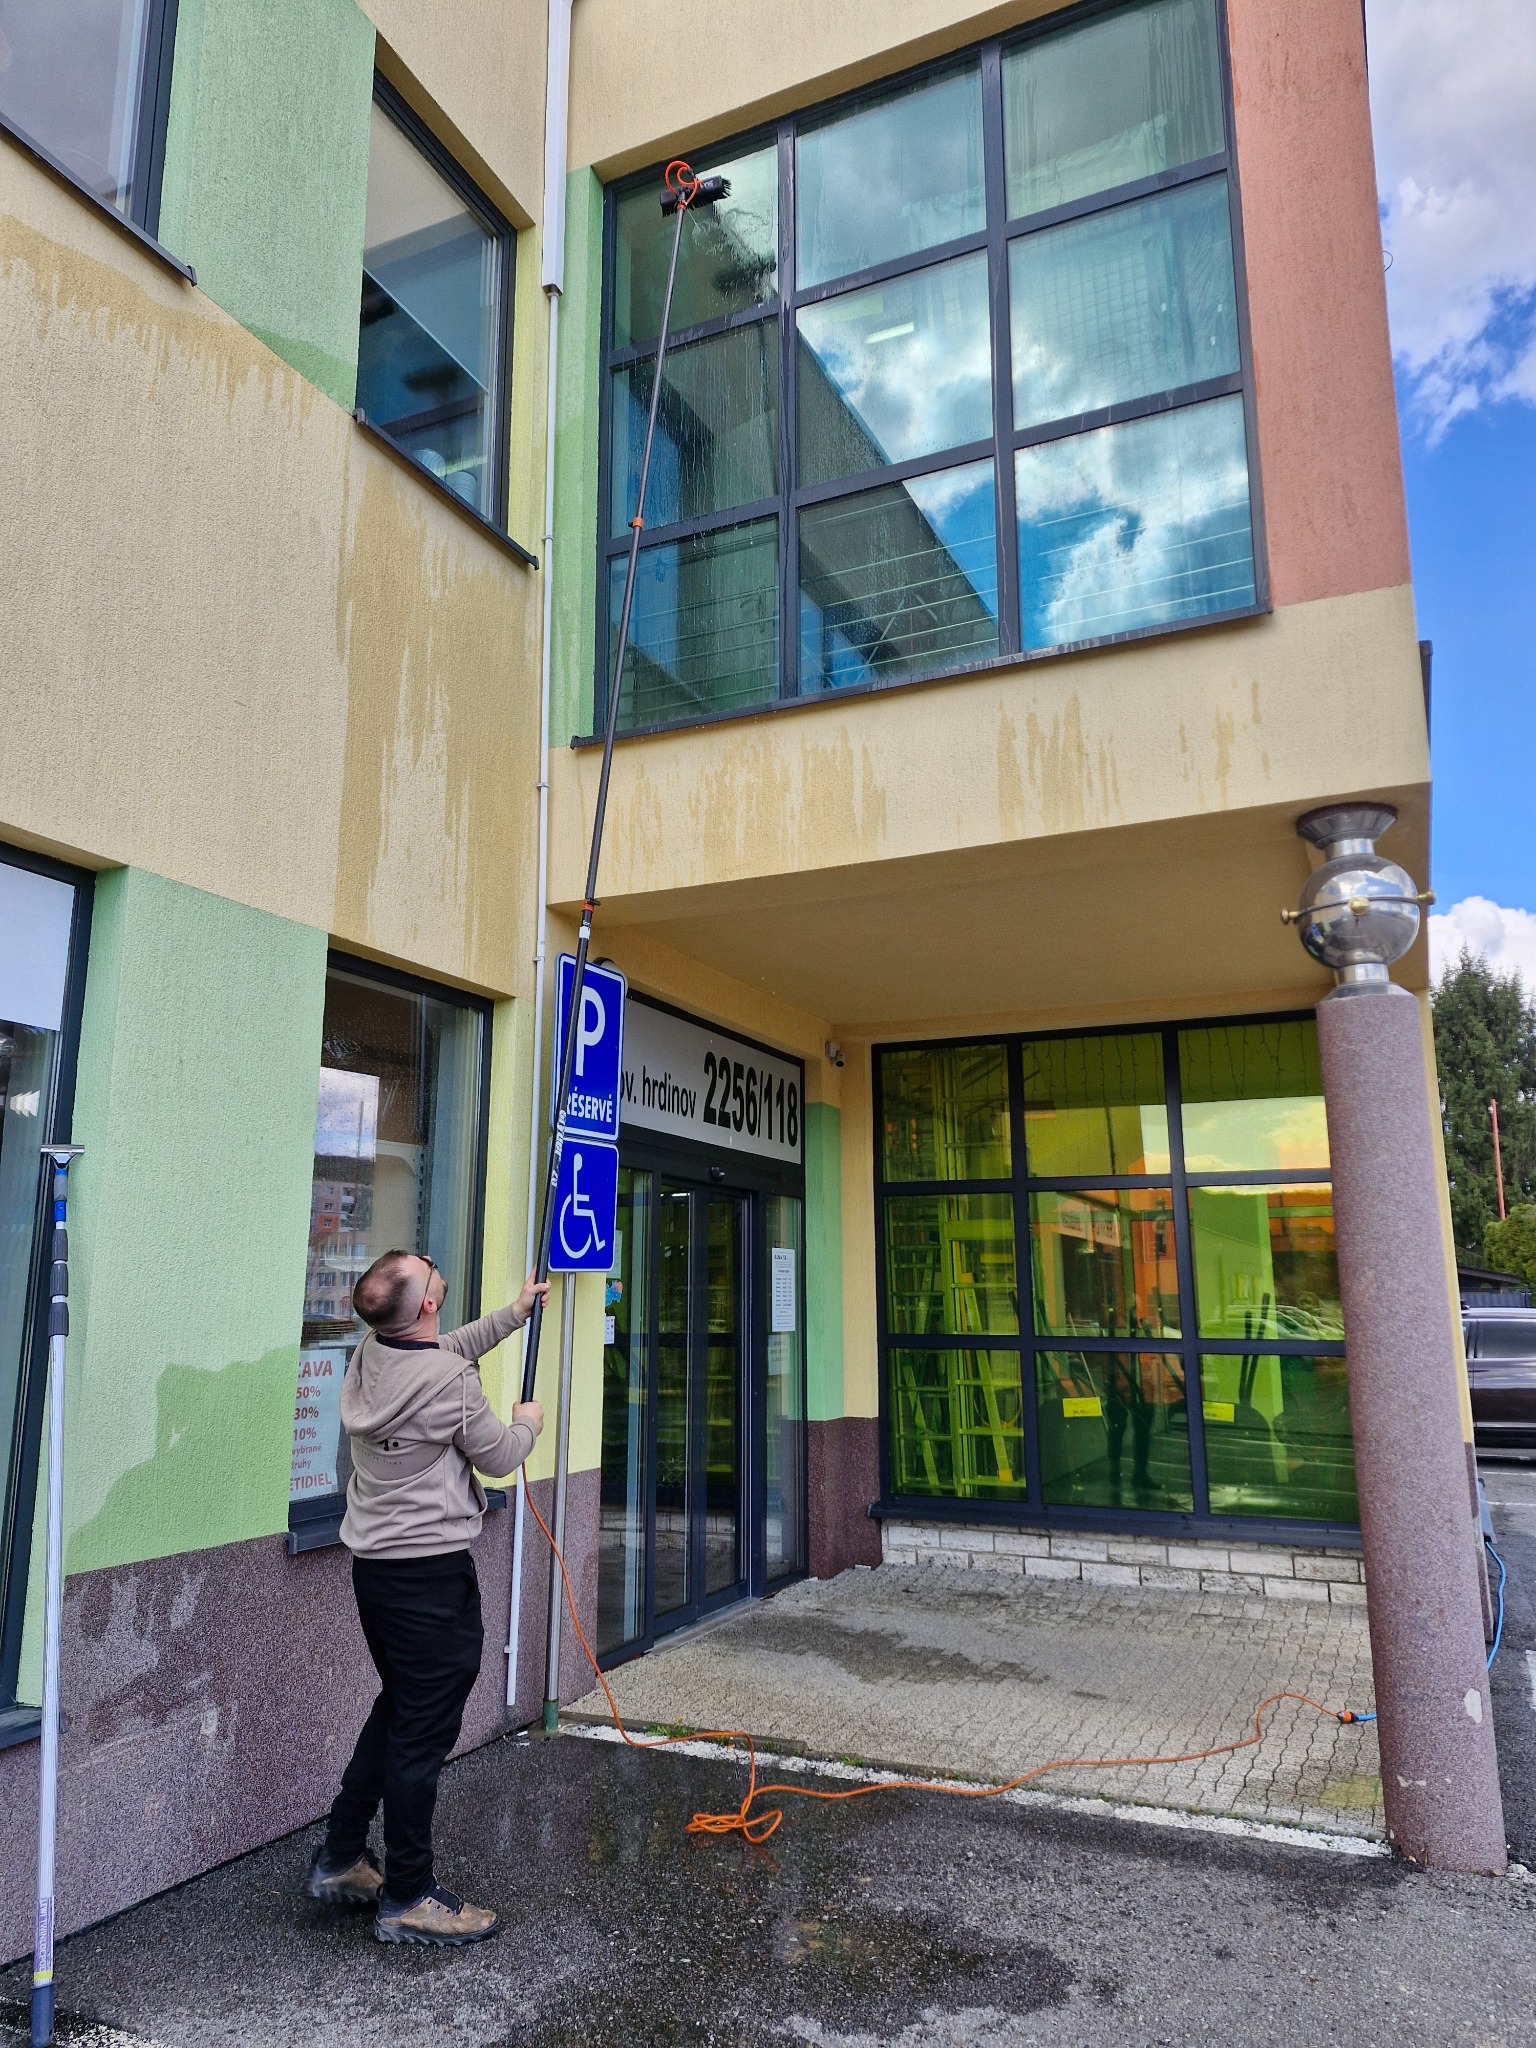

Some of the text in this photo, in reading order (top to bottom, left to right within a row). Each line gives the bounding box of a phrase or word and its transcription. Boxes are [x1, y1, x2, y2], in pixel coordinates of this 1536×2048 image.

[575, 985, 606, 1077] P
[642, 1064, 697, 1119] hrdinov
[703, 1051, 798, 1147] 2256/118
[298, 1360, 333, 1378] AVA
[296, 1385, 321, 1399] 50%
[294, 1406, 319, 1420] 30%
[293, 1427, 317, 1441] 10%
[292, 1443, 321, 1457] vybrané
